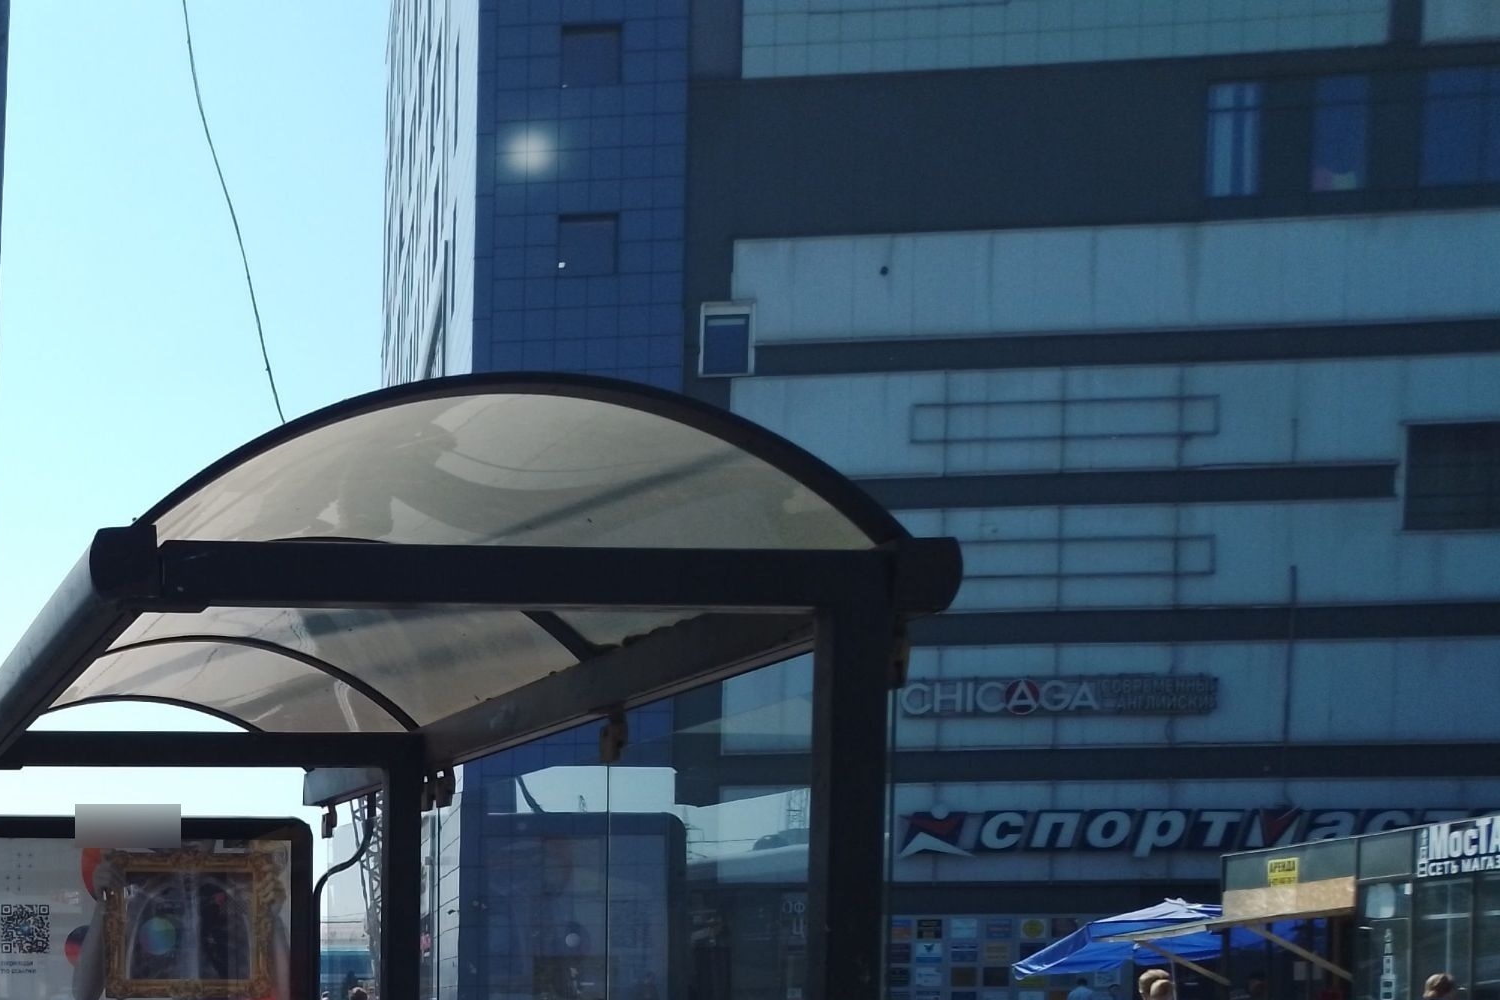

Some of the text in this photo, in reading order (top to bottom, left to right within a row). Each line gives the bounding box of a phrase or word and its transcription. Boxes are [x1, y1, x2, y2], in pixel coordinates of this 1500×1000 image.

[902, 679, 1100, 715] CHICAGA
[1269, 860, 1296, 873] АРЕНДА
[1428, 860, 1460, 876] СЕТЬ
